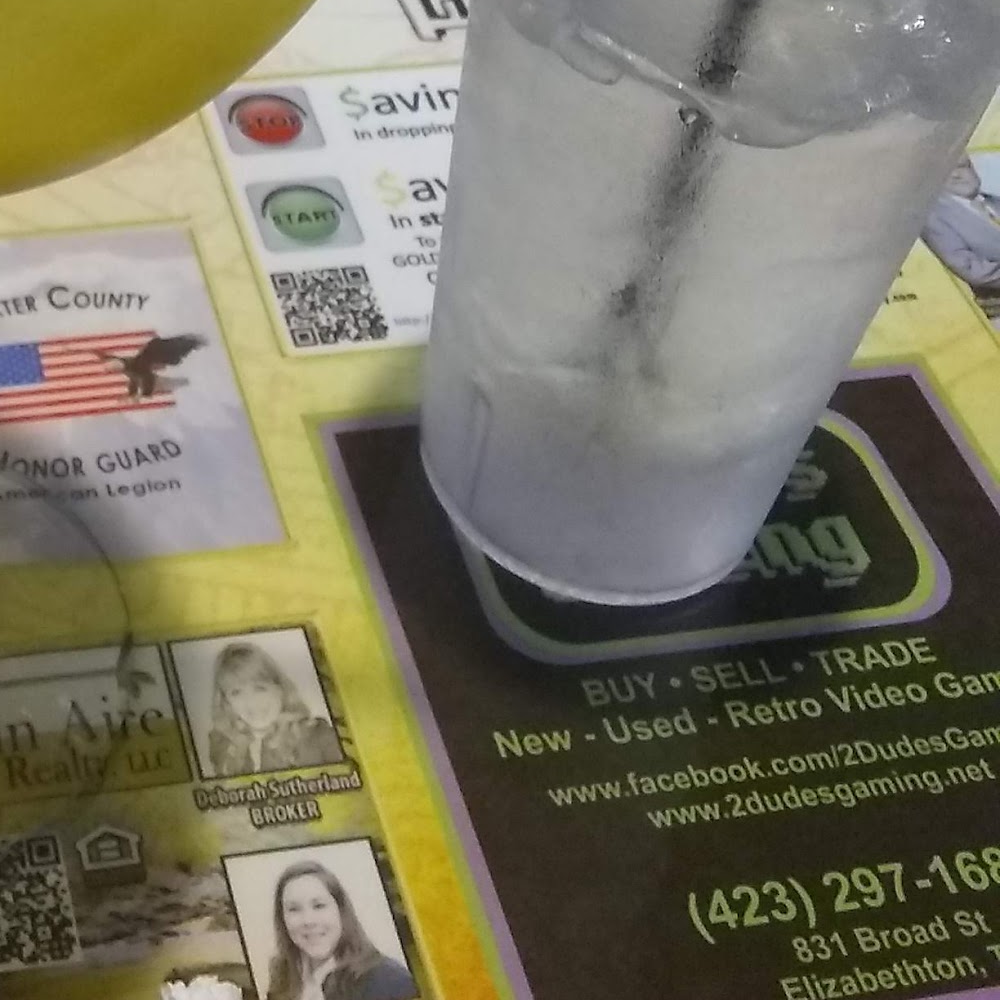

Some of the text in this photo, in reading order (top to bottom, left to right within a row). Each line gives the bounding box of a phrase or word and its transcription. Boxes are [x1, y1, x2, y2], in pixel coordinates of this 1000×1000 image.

[354, 128, 372, 141] In
[272, 210, 338, 227] START
[390, 213, 413, 229] In
[416, 235, 437, 249] To
[47, 285, 152, 312] COUNTY
[97, 438, 182, 476] GUARD
[105, 477, 182, 499] Legion
[581, 637, 937, 707] BUY SELL TRADE
[63, 694, 165, 752] Aire
[493, 729, 572, 758] New
[602, 707, 698, 744] Used
[724, 696, 823, 728] Retro
[824, 682, 928, 713] Video
[196, 770, 362, 809] Deborah Sutherland
[647, 758, 996, 829] www.2dudesgaming.net
[250, 799, 320, 827] BROKER
[688, 876, 817, 945] (423)
[791, 931, 849, 963] 831
[853, 915, 951, 954] Broad
[953, 909, 992, 937] St
[780, 955, 988, 1000] Elizabethton,
